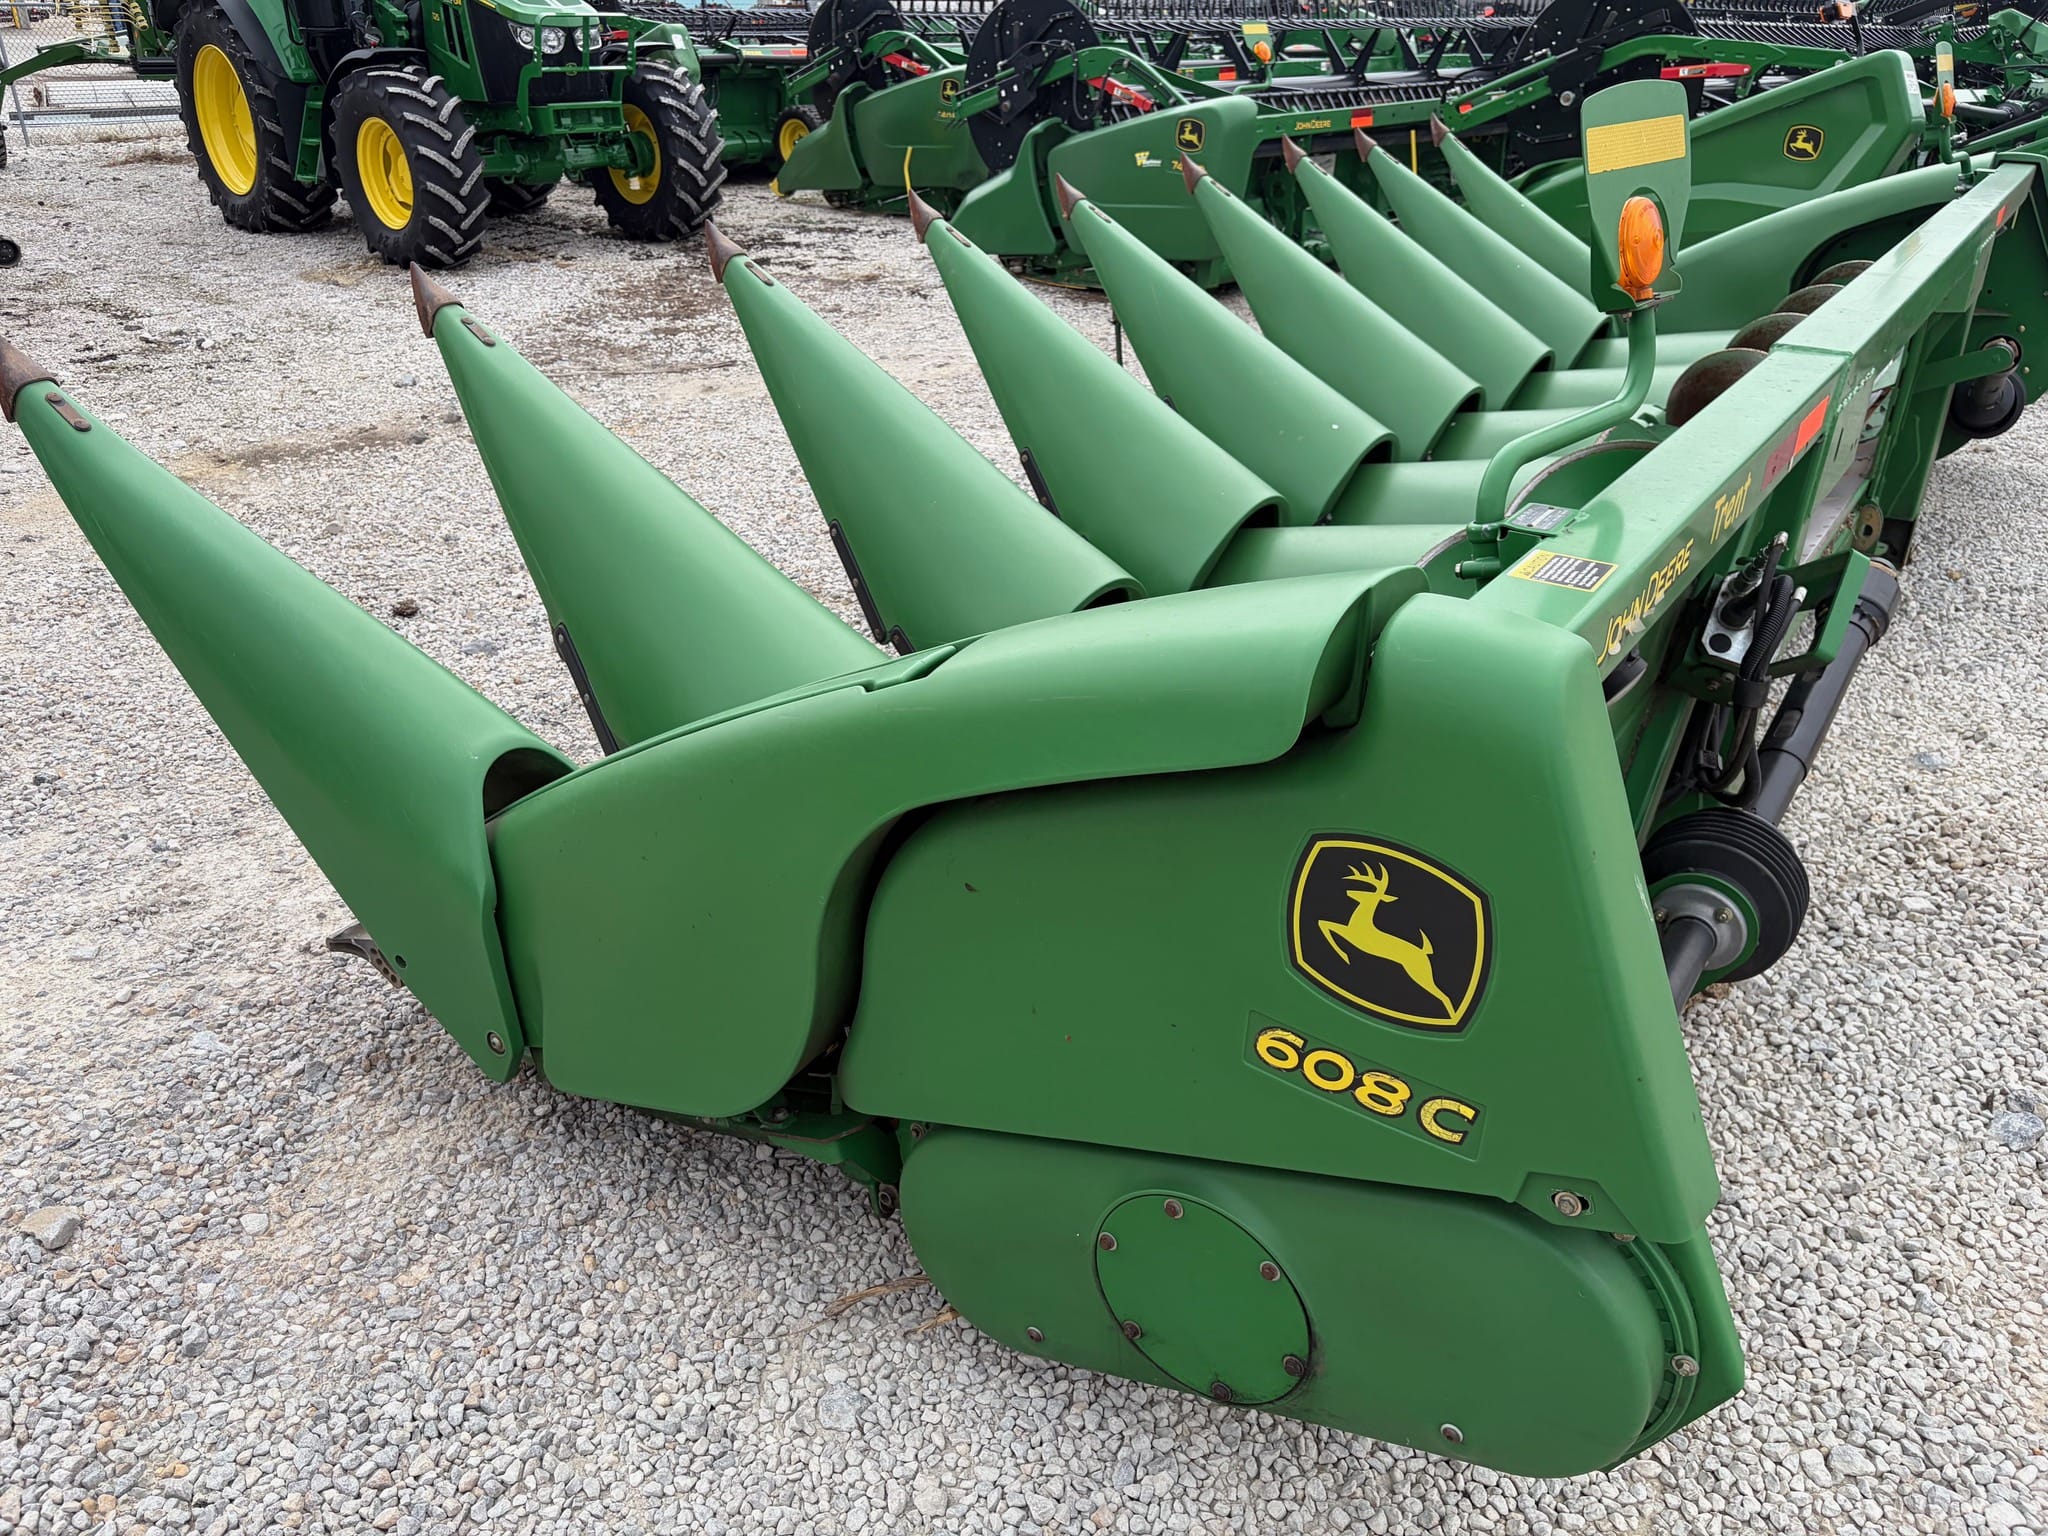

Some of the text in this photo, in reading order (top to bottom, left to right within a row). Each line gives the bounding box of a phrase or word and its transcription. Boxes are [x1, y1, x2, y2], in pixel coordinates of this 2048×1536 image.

[1710, 471, 1753, 545] Trent
[1597, 537, 1695, 666] JOHN DEERE
